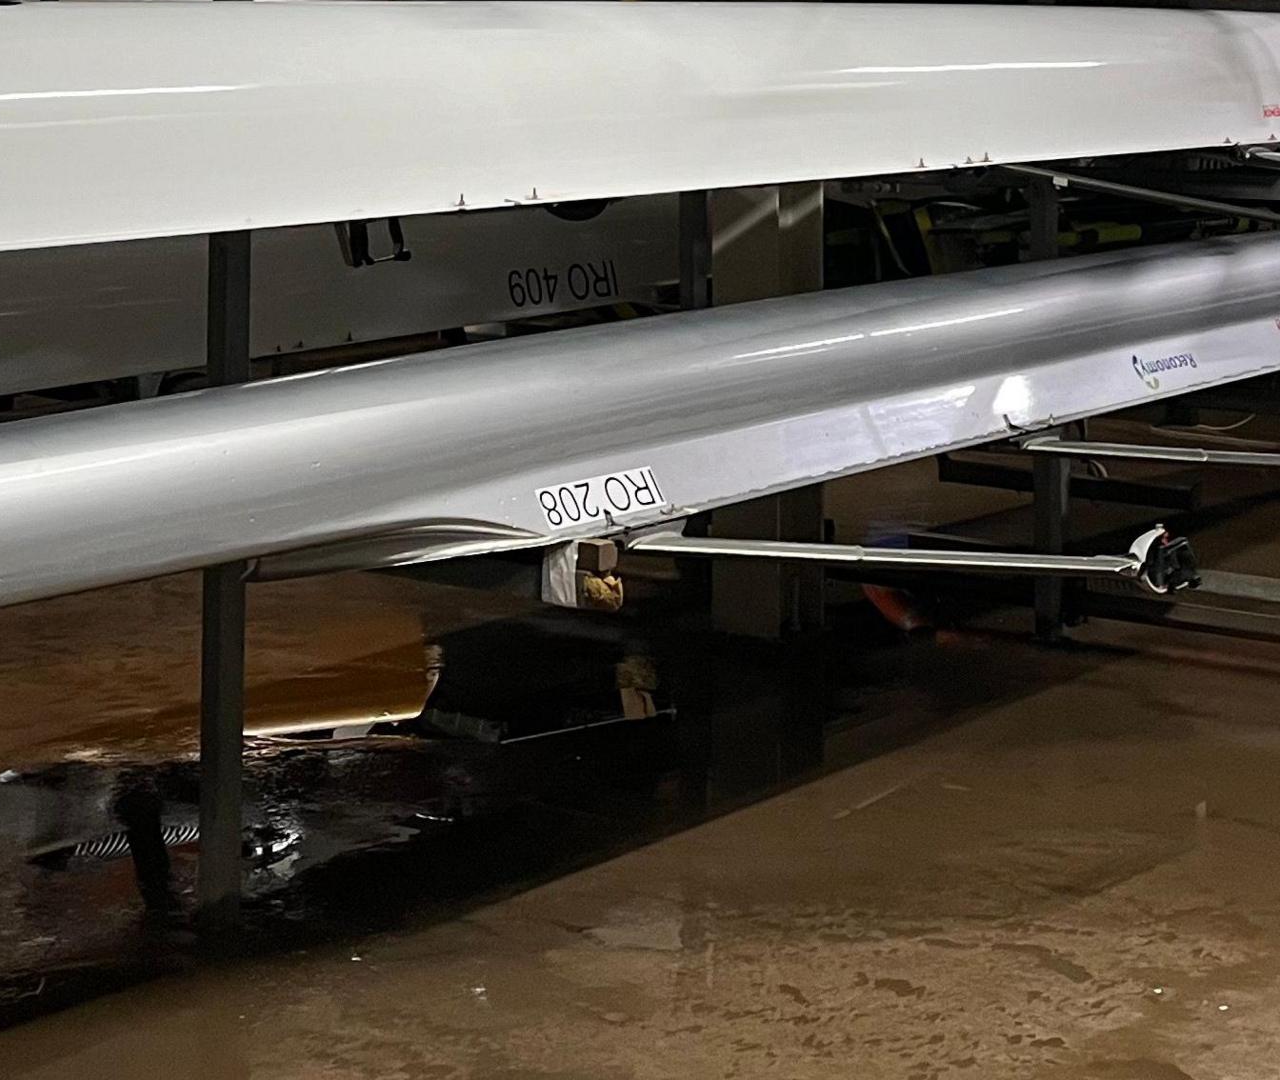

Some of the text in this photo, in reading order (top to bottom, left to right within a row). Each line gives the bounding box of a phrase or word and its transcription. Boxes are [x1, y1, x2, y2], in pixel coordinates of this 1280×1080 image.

[507, 260, 620, 307] IRO 409
[1140, 352, 1197, 377] Reconomy
[539, 468, 666, 526] IRO 208
